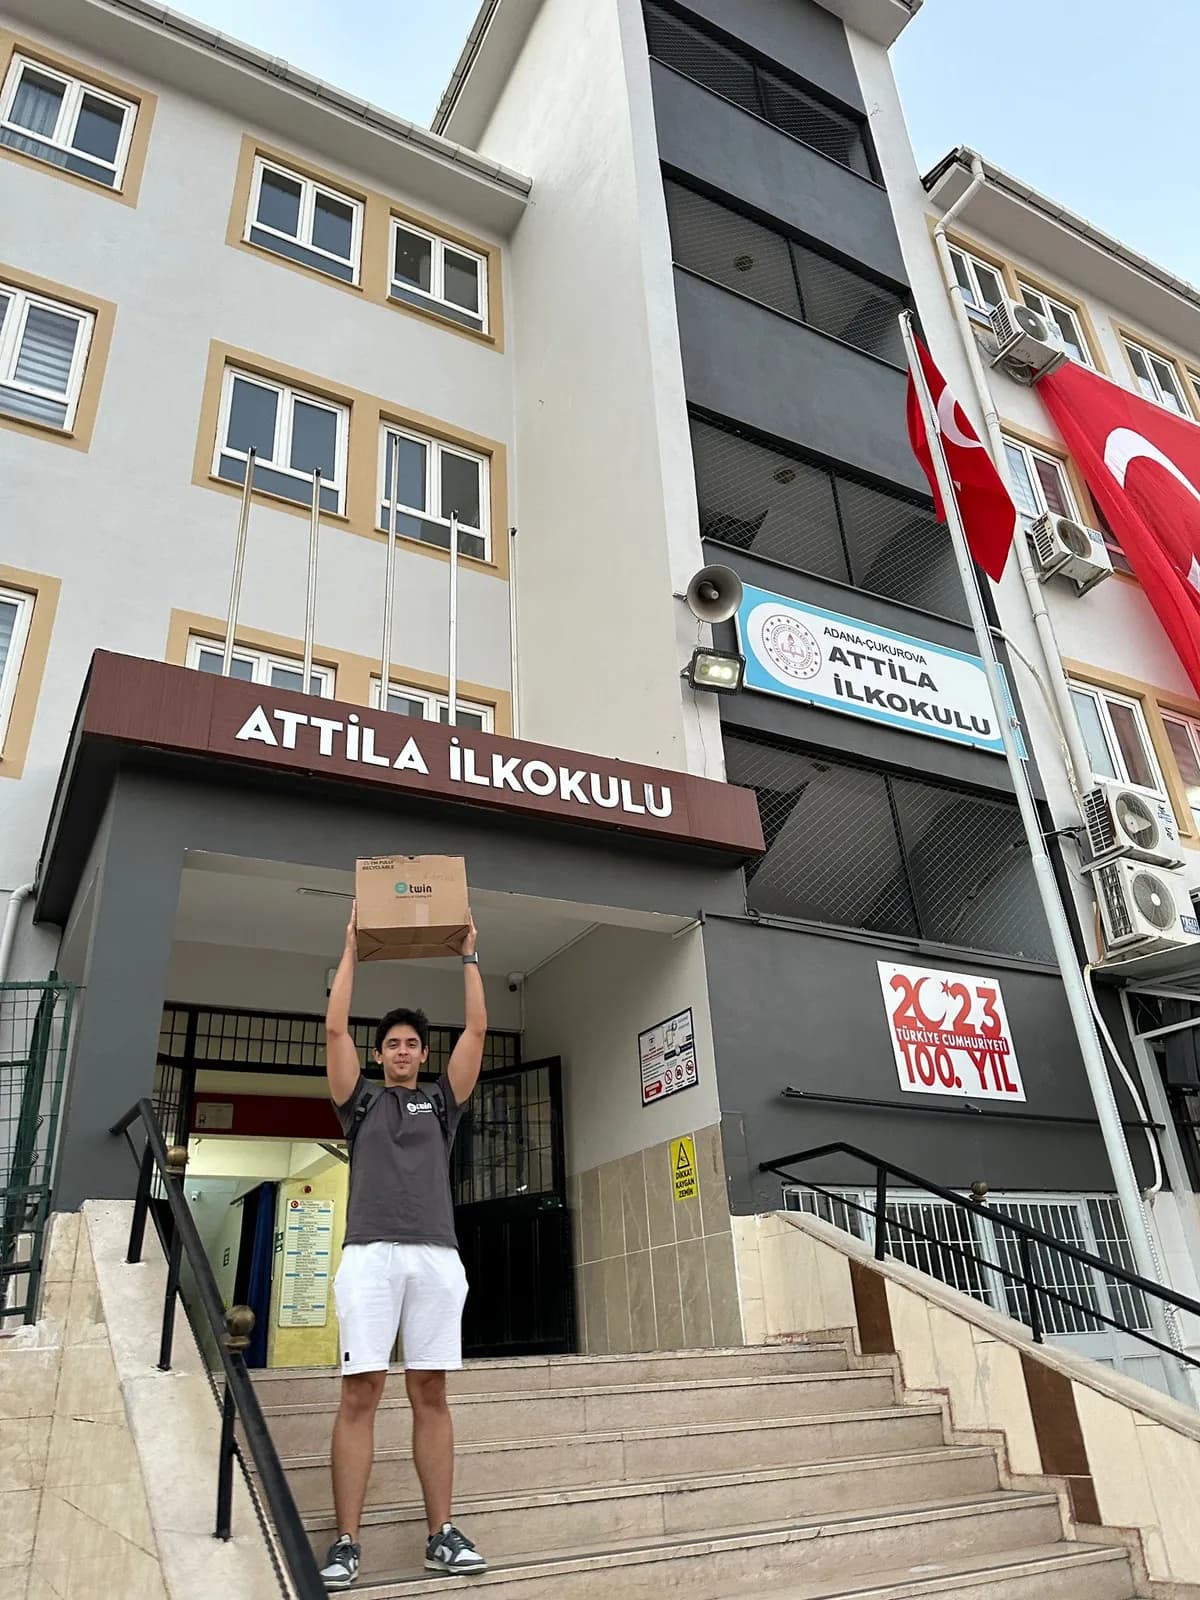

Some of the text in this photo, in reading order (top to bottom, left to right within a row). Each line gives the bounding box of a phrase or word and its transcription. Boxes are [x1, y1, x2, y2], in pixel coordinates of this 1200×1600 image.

[823, 626, 928, 666] ADANA-ÇUKUROVA
[828, 646, 939, 692] ATTİLA
[833, 673, 991, 736] İLKOKULU
[235, 704, 673, 818] ATTİLA İLKOKULU
[409, 884, 432, 894] twin
[896, 1025, 1009, 1053] TÜRKİYE CUMHURİYETİ
[899, 1043, 1018, 1093] 100. YIL
[675, 1168, 693, 1180] DİKKAT
[675, 1178, 695, 1189] KAYGAN
[678, 1188, 694, 1198] ZEMİN
